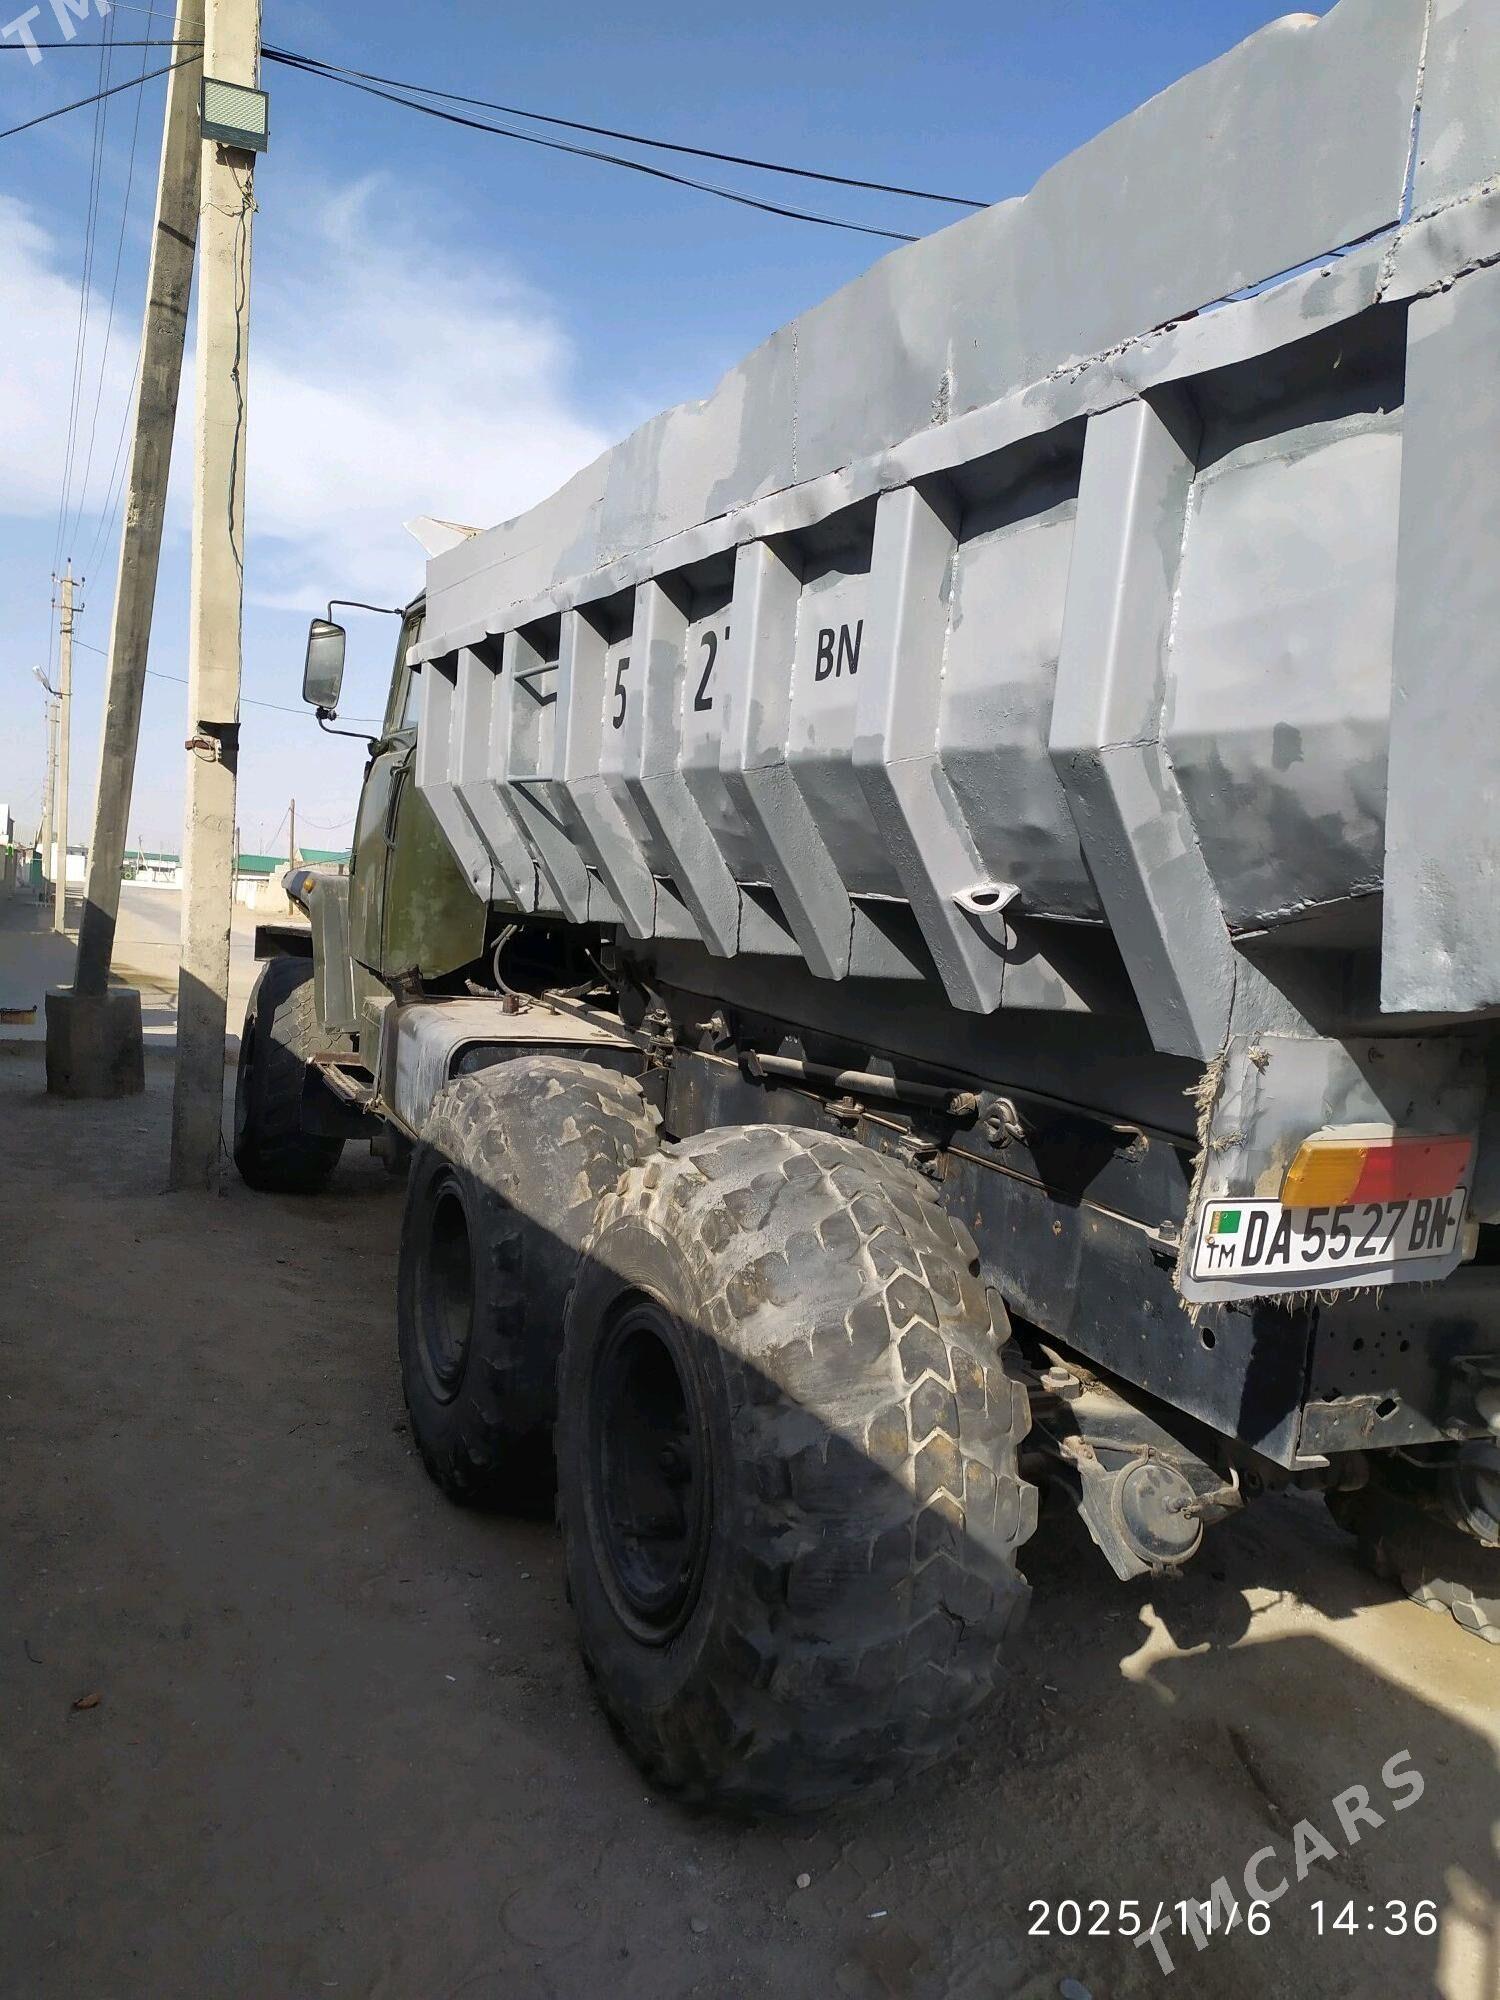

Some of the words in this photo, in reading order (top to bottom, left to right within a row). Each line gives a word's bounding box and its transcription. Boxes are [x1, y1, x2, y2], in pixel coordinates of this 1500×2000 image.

[815, 620, 864, 681] BN
[1207, 1244, 1235, 1269] TM
[1241, 1210, 1294, 1266] DA
[1302, 1201, 1408, 1262] 5527
[1408, 1197, 1453, 1250] BN
